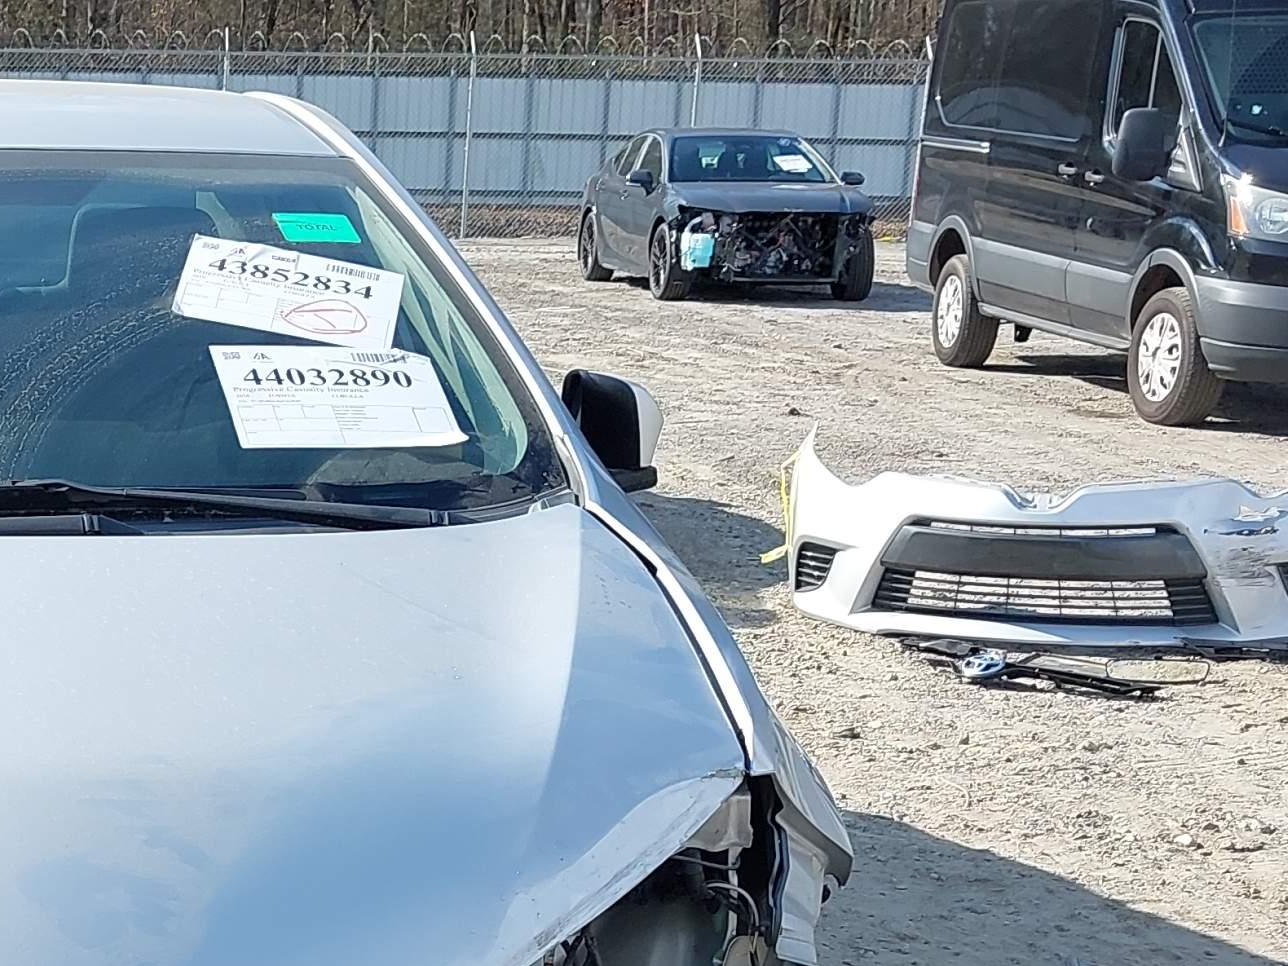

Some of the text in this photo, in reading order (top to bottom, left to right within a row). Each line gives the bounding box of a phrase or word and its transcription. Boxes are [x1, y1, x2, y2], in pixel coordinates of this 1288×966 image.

[295, 223, 337, 231] TOTAL
[208, 257, 374, 299] 43852834
[243, 367, 412, 388] 44032890
